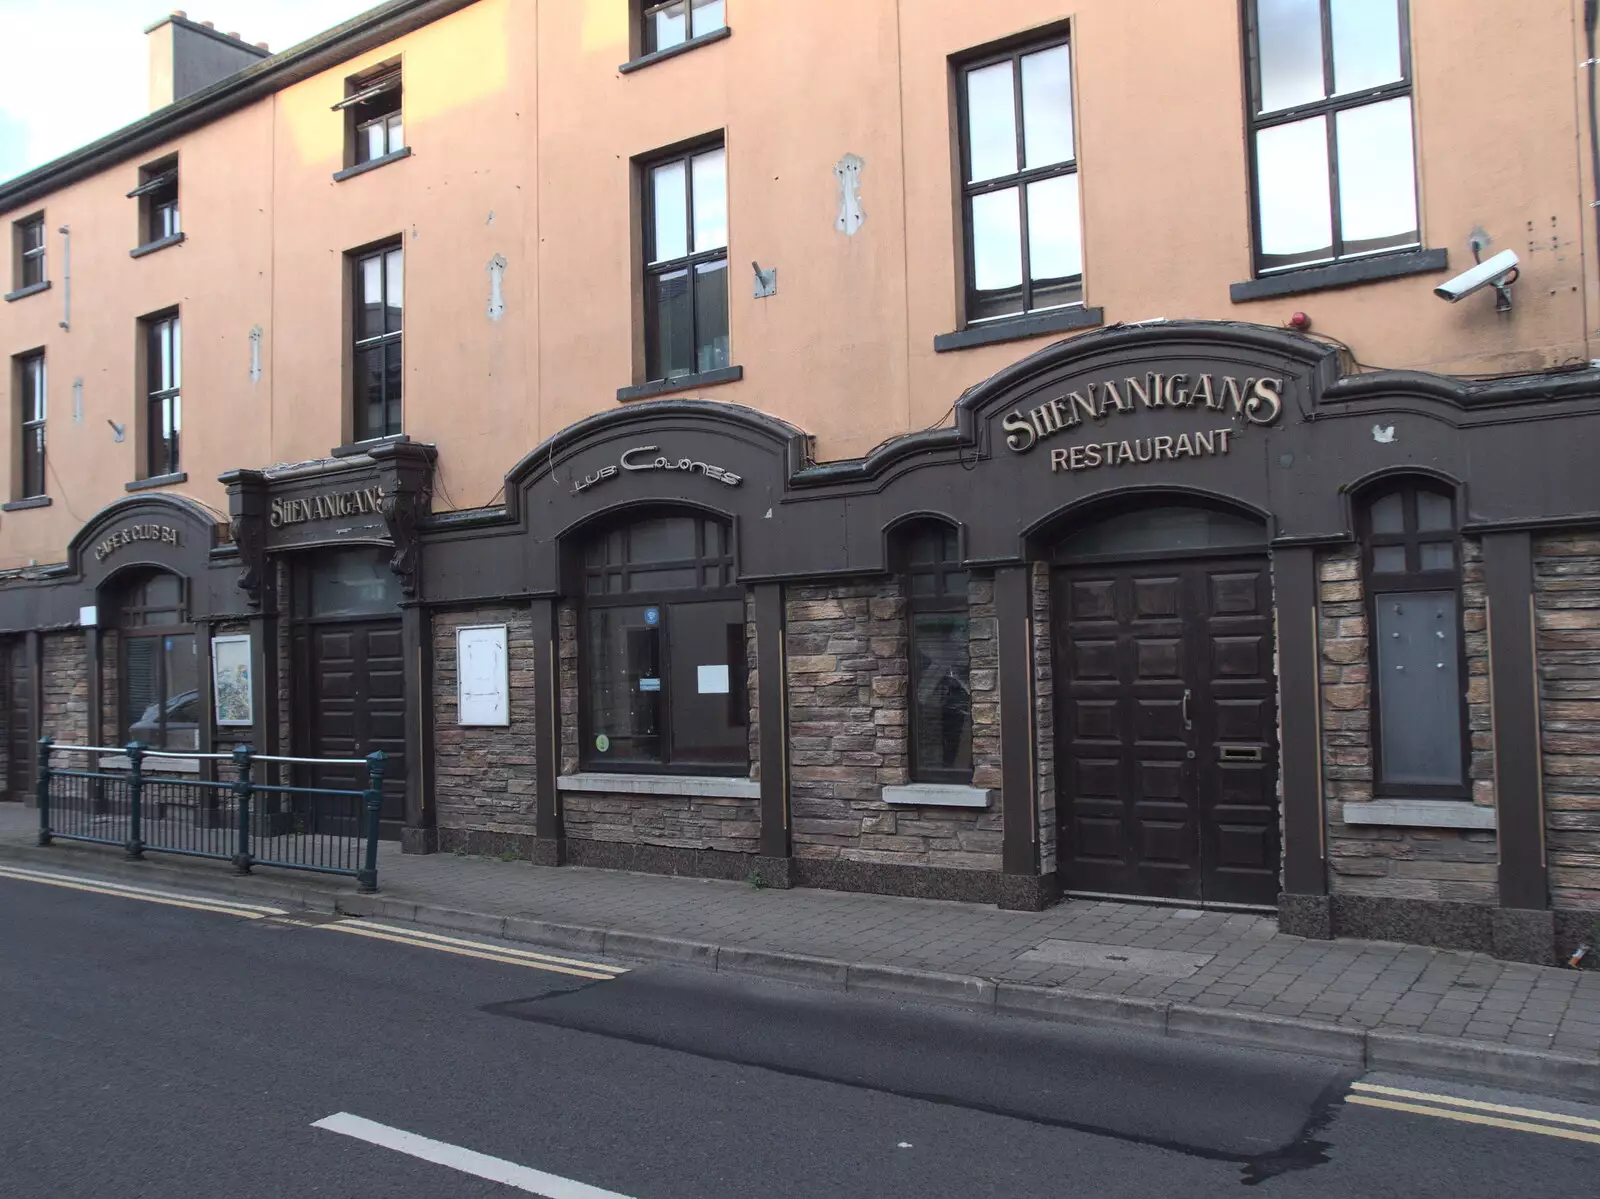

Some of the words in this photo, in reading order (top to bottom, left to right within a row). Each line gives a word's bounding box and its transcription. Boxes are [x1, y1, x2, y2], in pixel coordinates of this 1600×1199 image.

[1002, 370, 1284, 452] SHENANIGANS
[1051, 428, 1235, 473] RESTAURANT
[569, 465, 618, 493] LUB
[131, 524, 159, 540] CLUB
